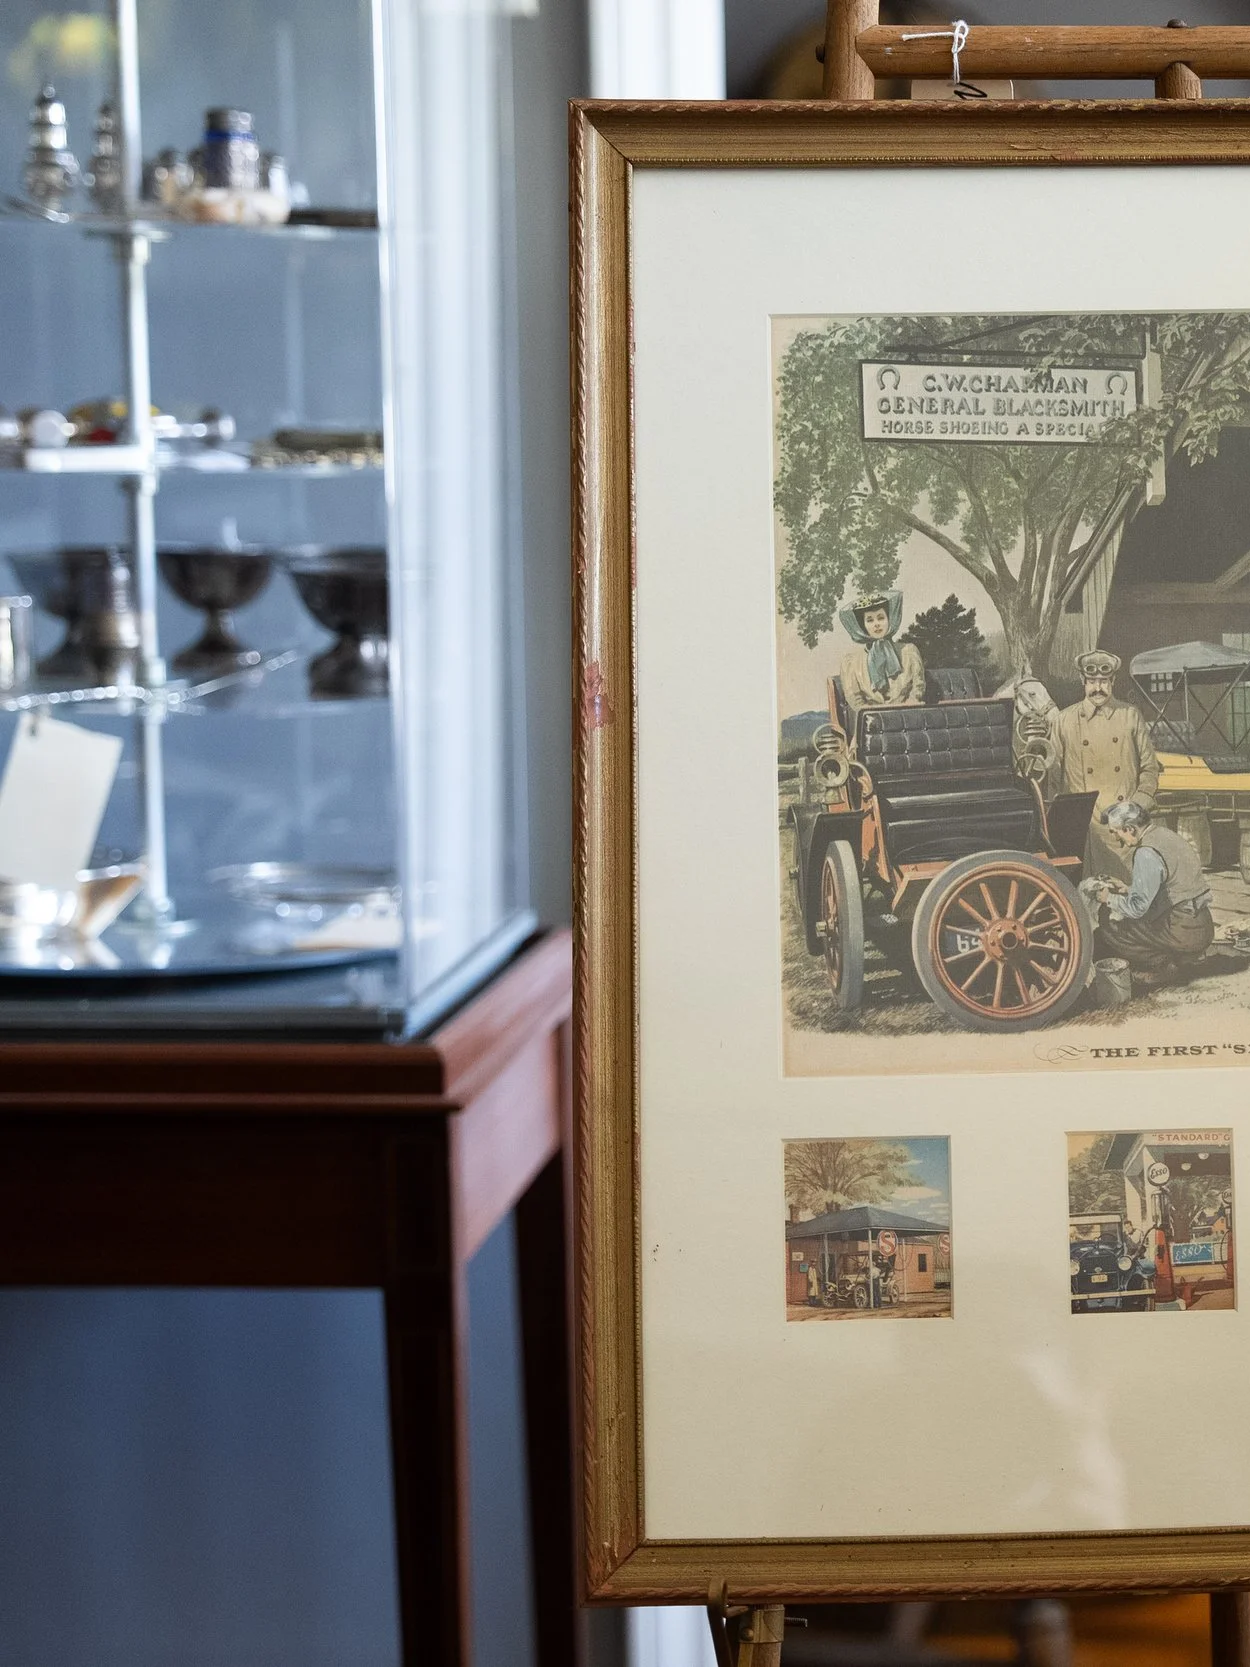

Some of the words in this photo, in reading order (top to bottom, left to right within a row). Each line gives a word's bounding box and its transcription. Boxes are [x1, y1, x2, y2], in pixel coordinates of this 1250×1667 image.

[876, 396, 986, 416] GENERAL
[992, 399, 1125, 417] BLACKSMITH
[881, 420, 934, 434] HORSE
[939, 421, 1009, 435] SHOEING
[1016, 423, 1029, 435] A
[1035, 423, 1101, 437] SPECIA
[1090, 1047, 1139, 1059] THE
[1147, 1045, 1216, 1057] FIRST
